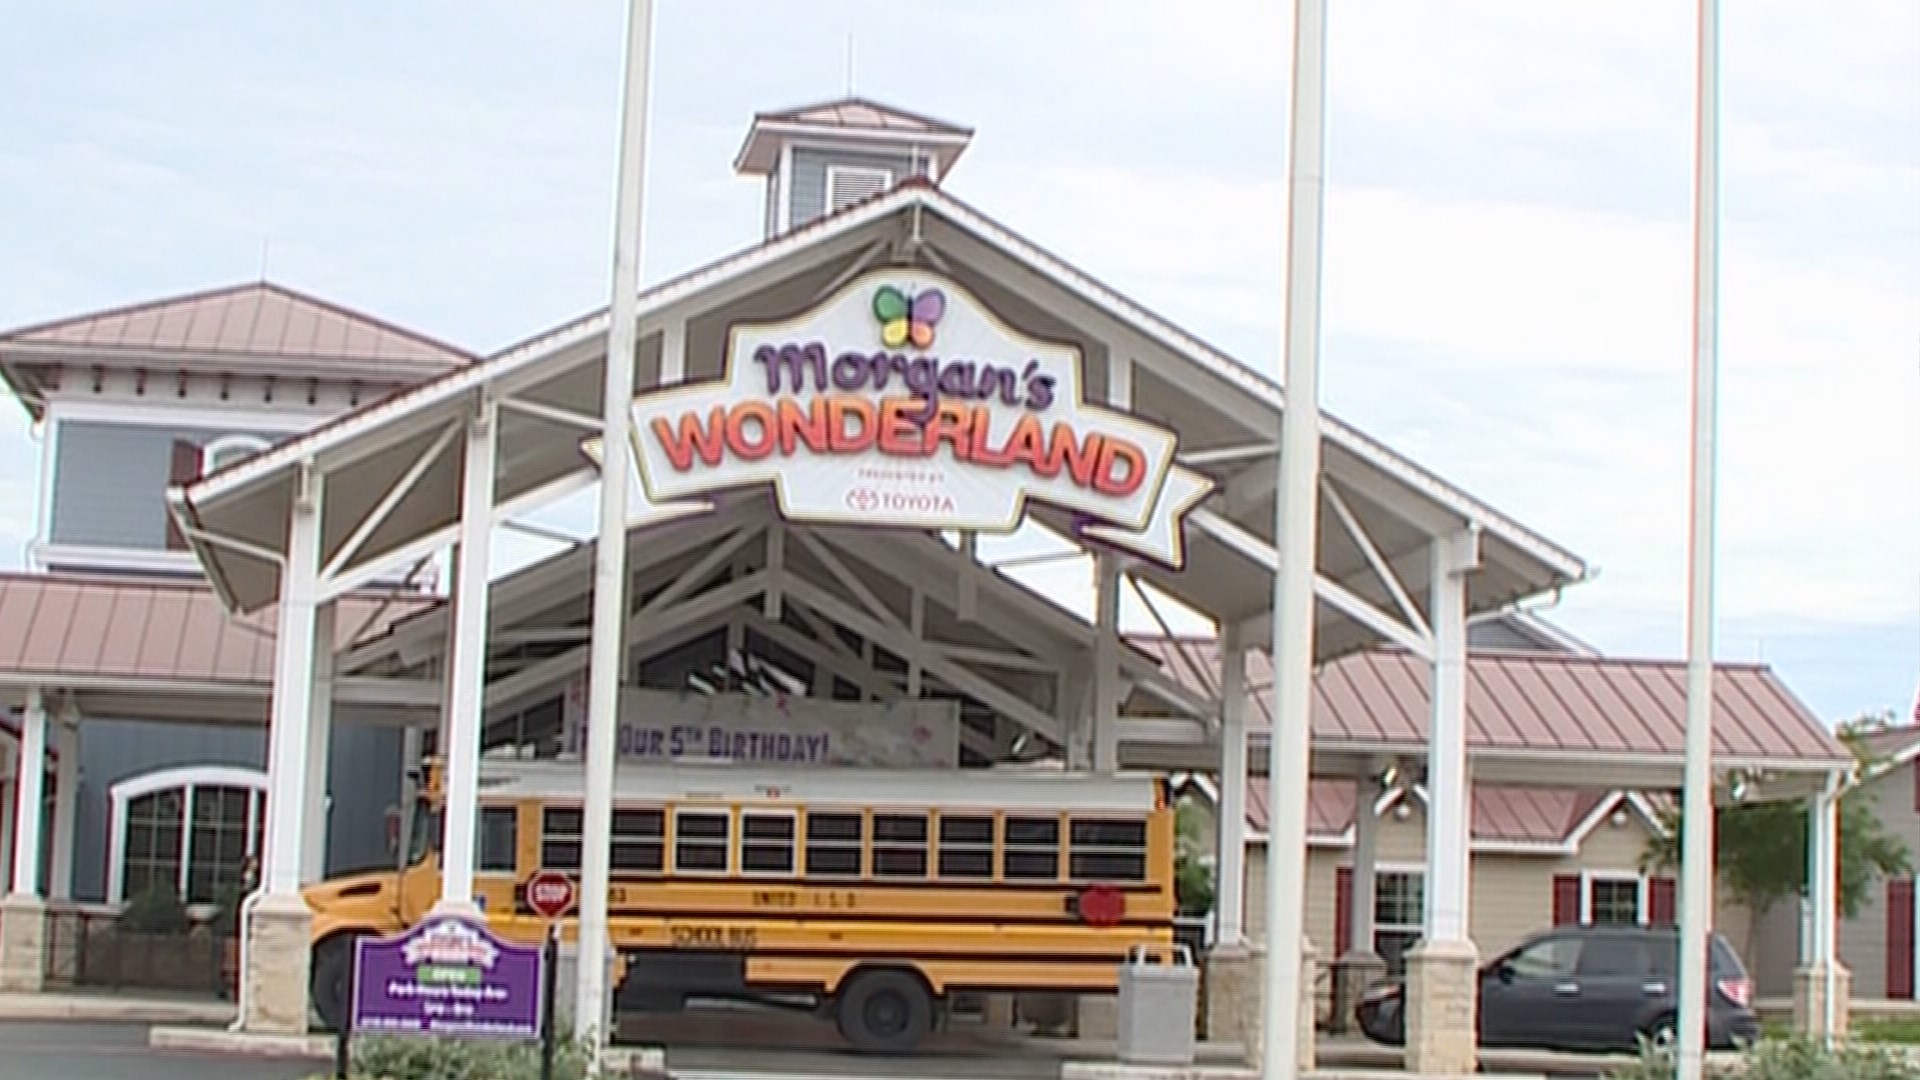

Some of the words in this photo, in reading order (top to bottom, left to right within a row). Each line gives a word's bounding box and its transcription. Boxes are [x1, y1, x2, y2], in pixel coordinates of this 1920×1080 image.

[753, 342, 1057, 426] Morgan's
[651, 397, 1148, 497] WONDERLAND
[882, 492, 955, 513] TOYOTA
[708, 727, 829, 762] BIRTHDAY!
[535, 883, 568, 902] STOP
